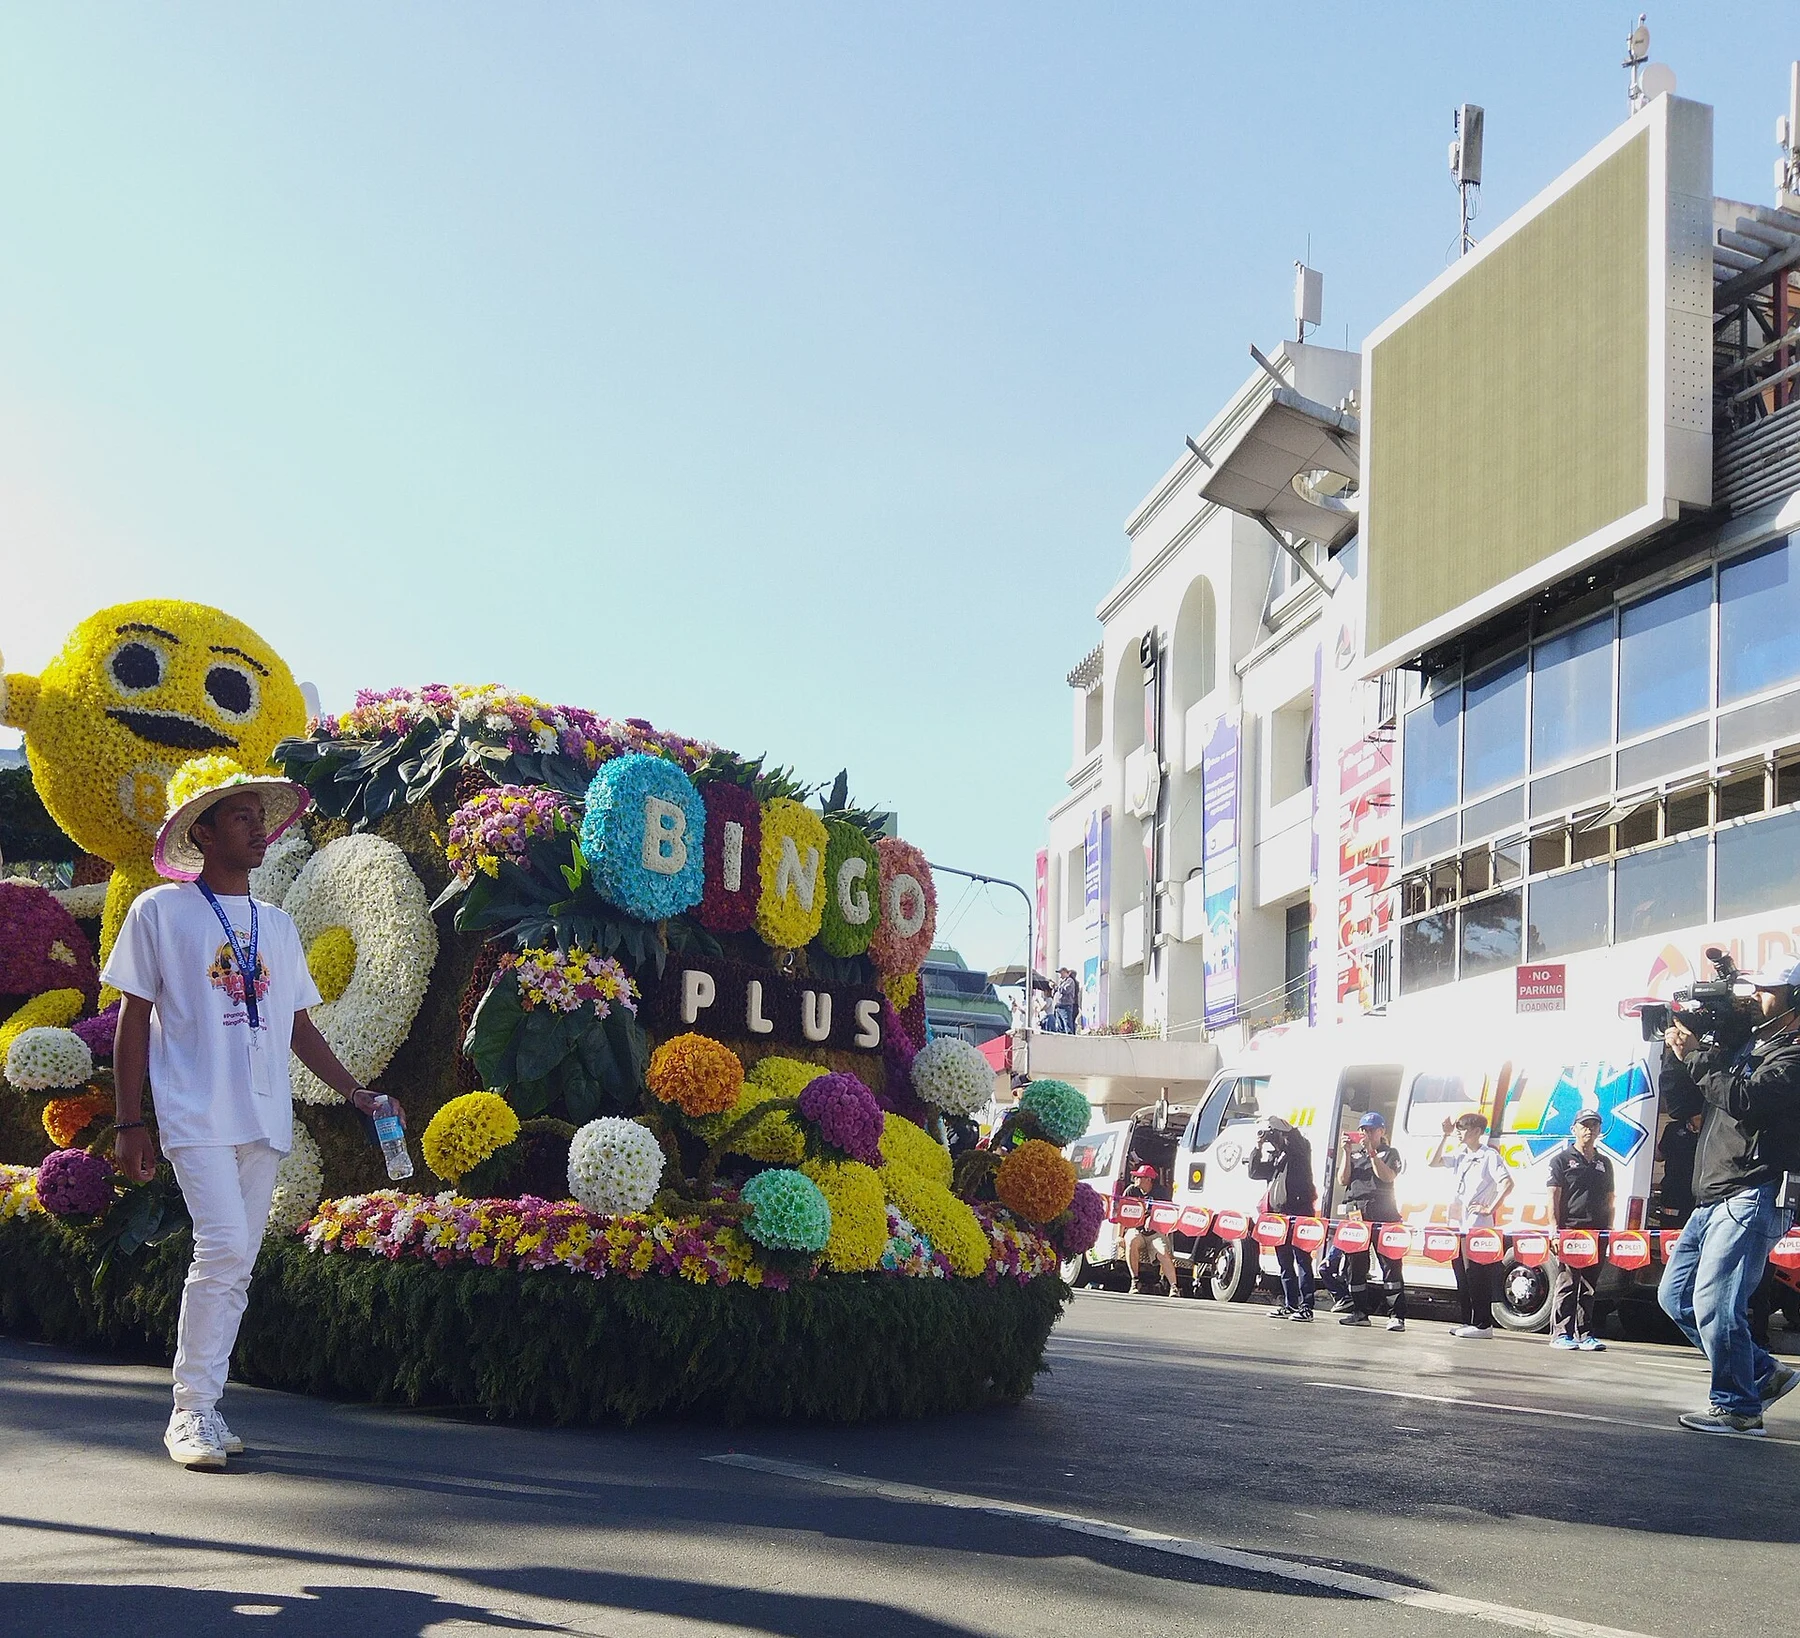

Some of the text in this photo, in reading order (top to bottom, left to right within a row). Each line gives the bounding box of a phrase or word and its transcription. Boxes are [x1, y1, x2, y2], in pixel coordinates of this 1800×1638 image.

[642, 795, 926, 939] BINGO
[1700, 925, 1800, 981] PLD
[1520, 984, 1563, 996] PARKING
[1532, 971, 1551, 981] NO
[681, 969, 881, 1049] PLUS
[1521, 1002, 1554, 1012] LOADING
